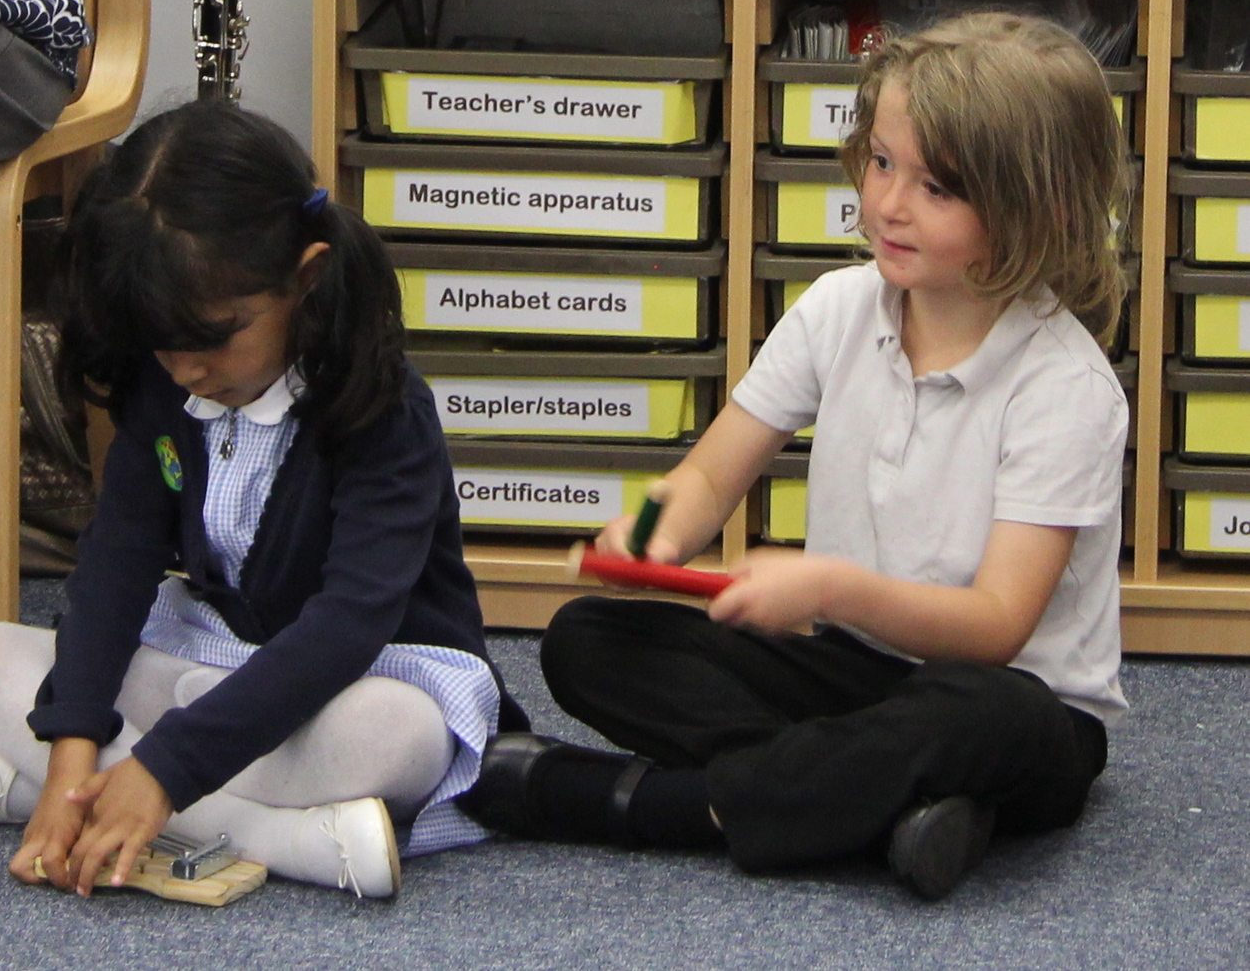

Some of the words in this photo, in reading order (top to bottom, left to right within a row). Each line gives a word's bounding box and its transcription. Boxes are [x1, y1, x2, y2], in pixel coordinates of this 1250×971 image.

[553, 96, 642, 119] drawer
[409, 183, 521, 209] Magnetic
[528, 192, 653, 213] apparatus
[439, 287, 551, 312] Alphabet
[557, 293, 627, 312] cards
[447, 394, 632, 421] Stapler/staples
[457, 480, 601, 505] Certificates
